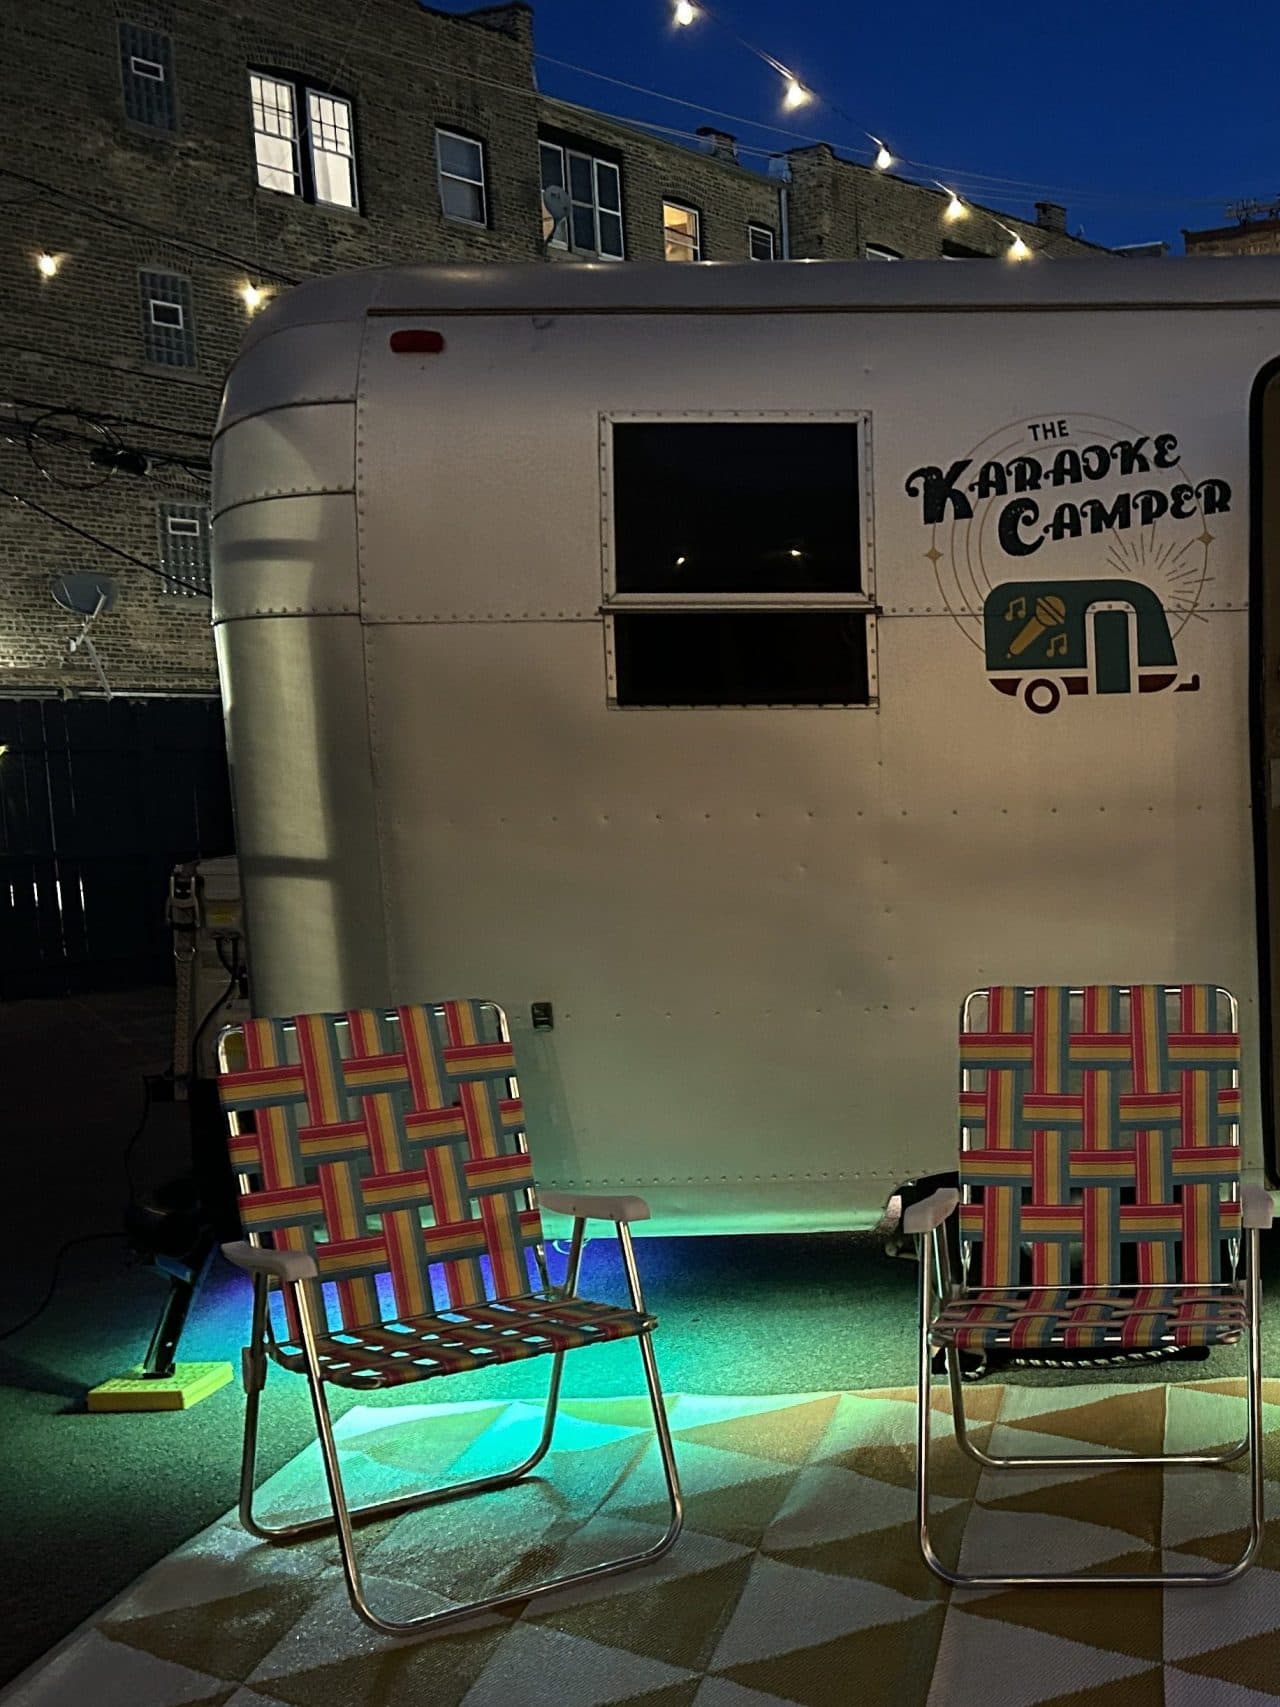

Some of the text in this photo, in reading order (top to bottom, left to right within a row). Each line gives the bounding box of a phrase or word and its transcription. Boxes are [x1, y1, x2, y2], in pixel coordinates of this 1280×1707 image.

[1027, 419, 1069, 442] THE
[905, 433, 1182, 525] KARAOKE
[998, 478, 1232, 556] CAMPER
